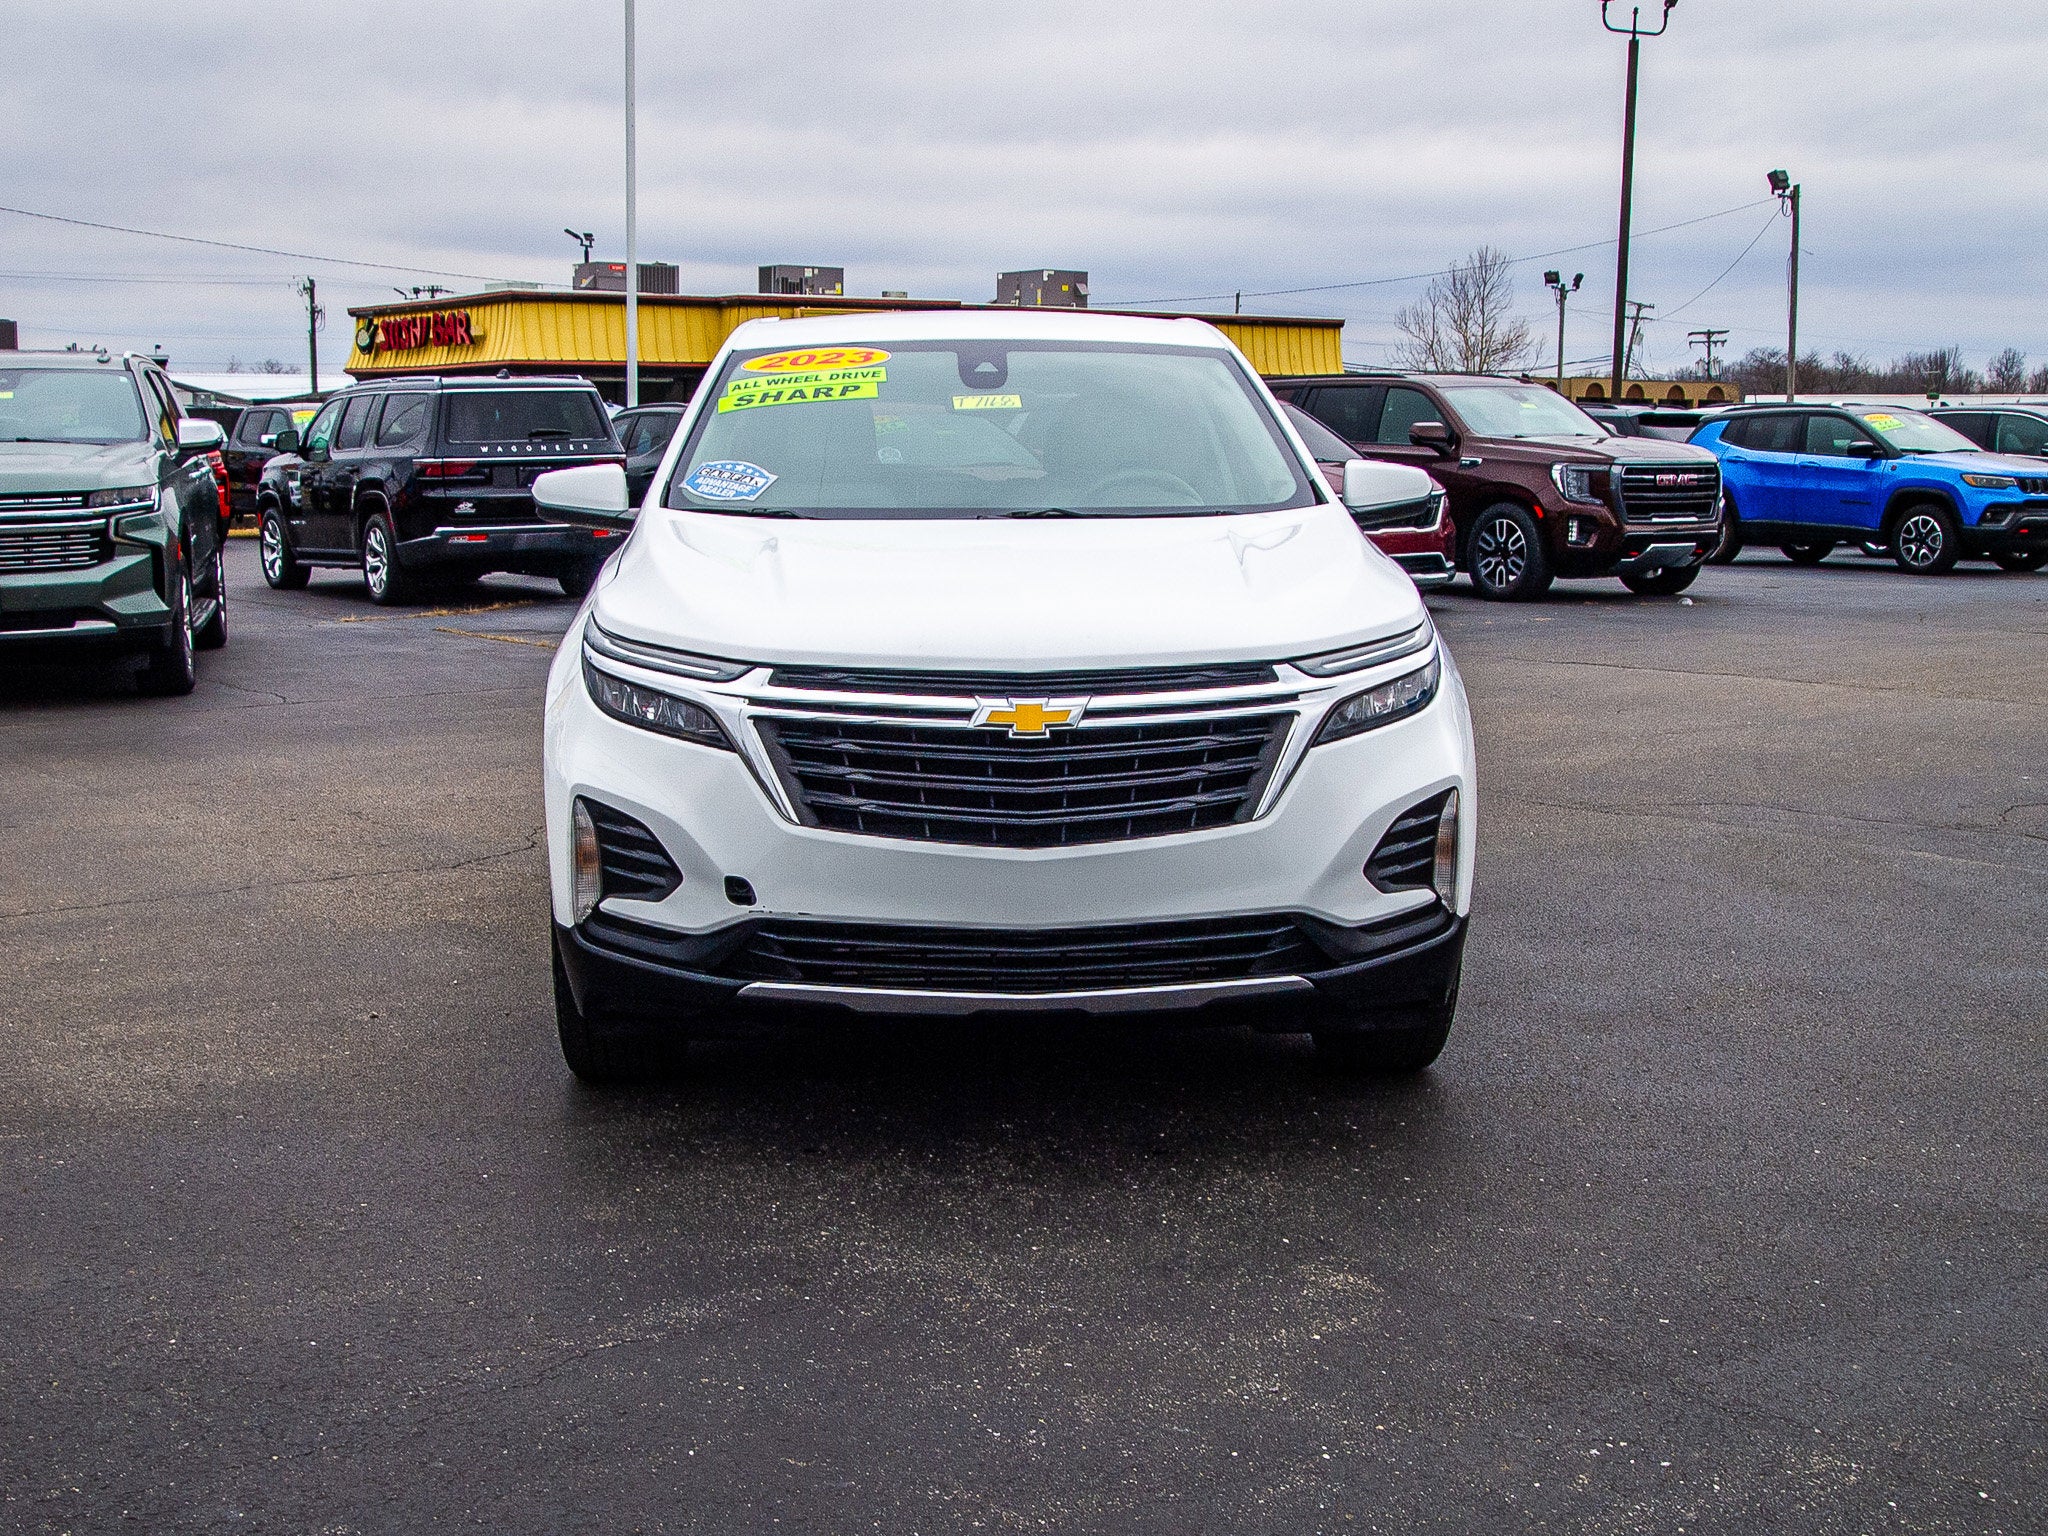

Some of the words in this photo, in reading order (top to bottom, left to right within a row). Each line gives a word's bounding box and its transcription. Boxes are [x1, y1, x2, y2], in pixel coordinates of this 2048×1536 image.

[380, 316, 431, 351] SUSHI
[432, 311, 474, 347] BAR
[759, 351, 875, 370] 2023
[731, 381, 763, 392] ALL
[766, 373, 822, 386] WHEEL
[829, 370, 882, 381] DRIVE
[733, 385, 860, 407] SHARP
[480, 443, 588, 453] WAGONEER
[694, 476, 752, 493] ADVANTAGE
[700, 468, 768, 488] CARFAX
[1656, 473, 1698, 486] GMC
[697, 484, 736, 497] DEALER
